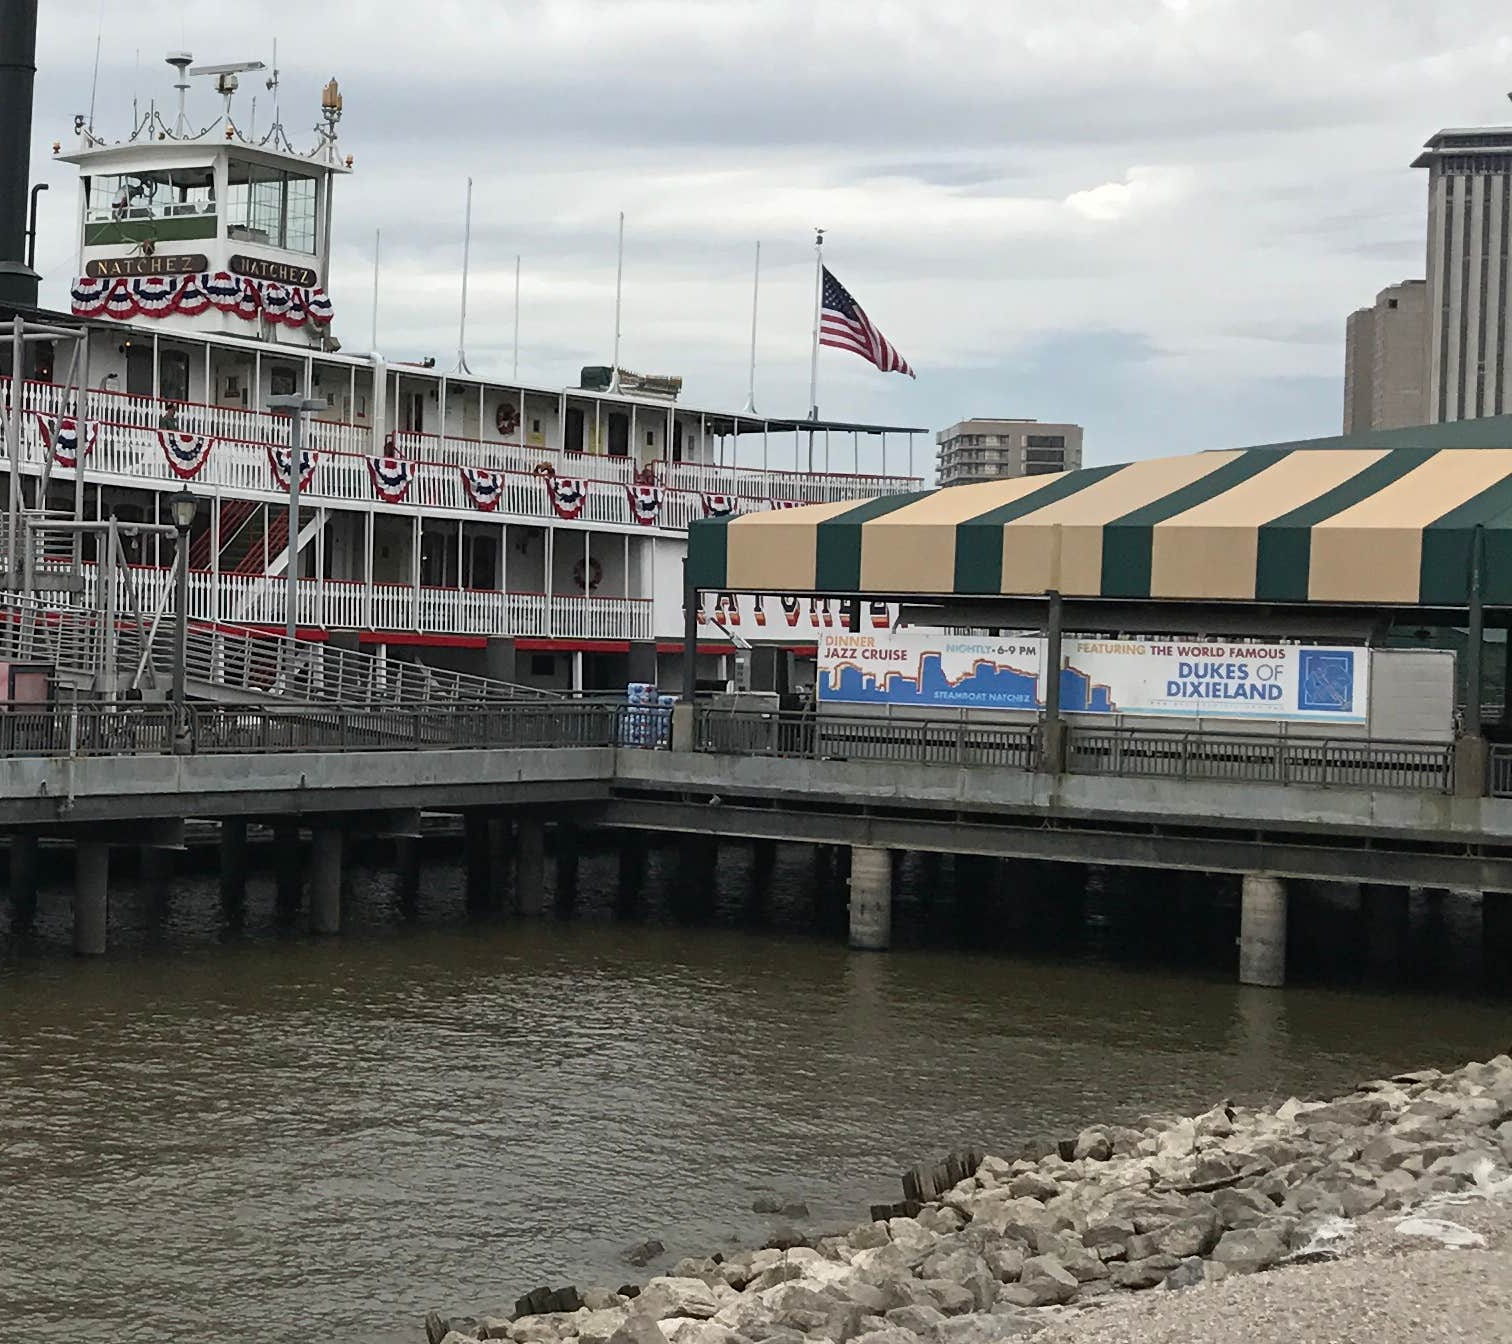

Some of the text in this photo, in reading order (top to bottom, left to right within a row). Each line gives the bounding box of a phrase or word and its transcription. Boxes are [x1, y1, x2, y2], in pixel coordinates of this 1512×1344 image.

[97, 256, 193, 275] NATCHEZ
[241, 258, 310, 284] NATCHEZ
[825, 636, 875, 647] DINNER
[946, 644, 992, 654] NIGHTLY
[1019, 646, 1037, 656] PM
[824, 647, 908, 661] JAZZ CRUISE
[1077, 642, 1286, 660] FEATURING THE WORLD FAMOUS
[1178, 662, 1284, 682] DUKES OF
[934, 690, 1031, 703] STEAMBOAT NATCHEZ
[1166, 680, 1283, 700] DIXIELAND
